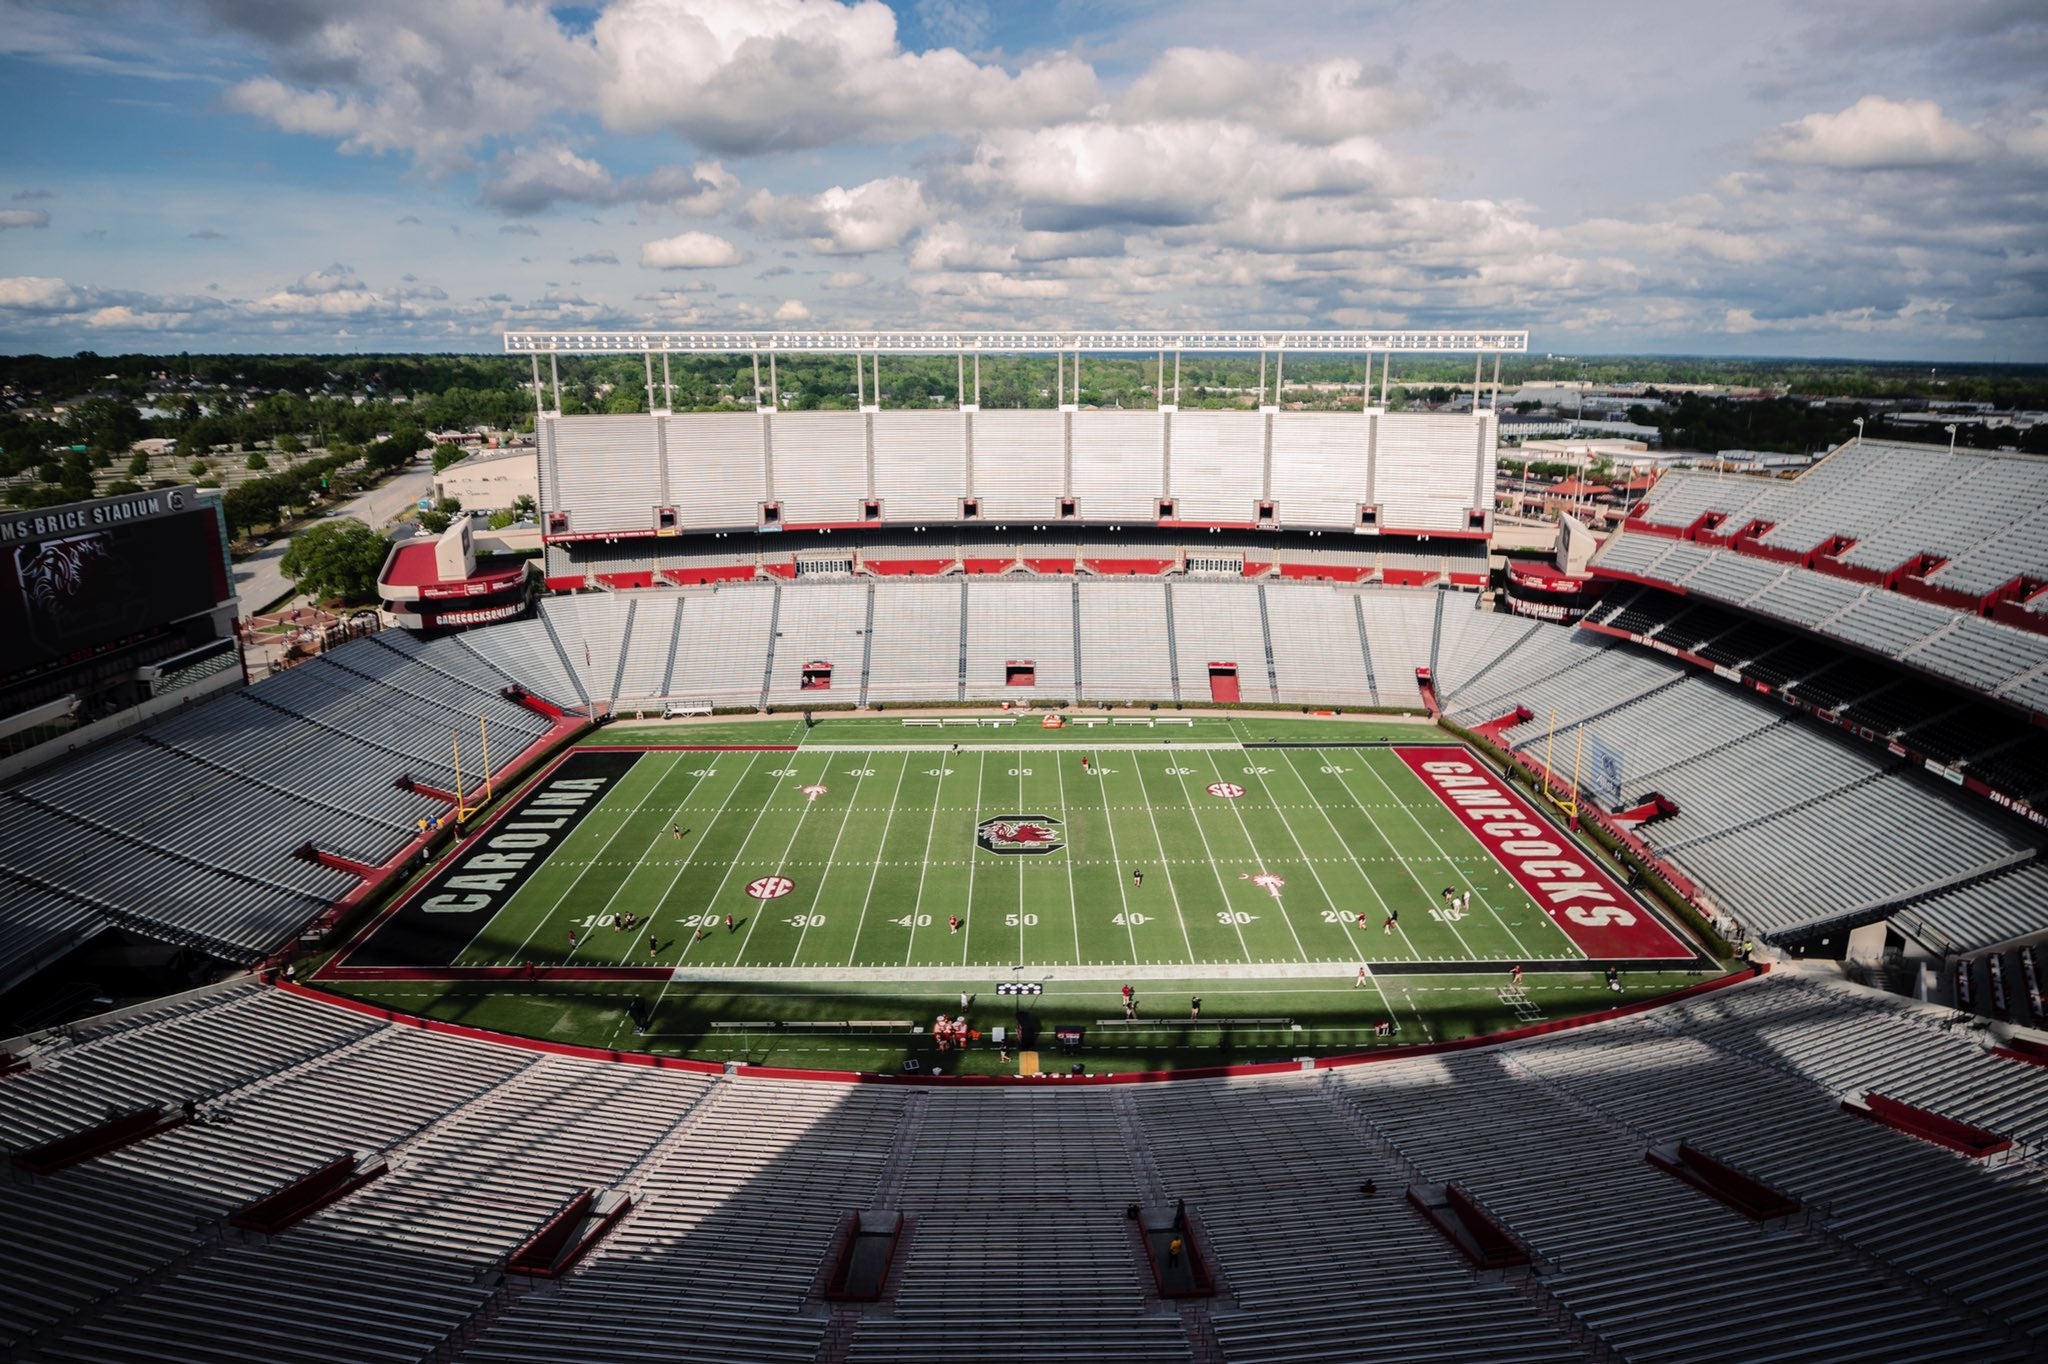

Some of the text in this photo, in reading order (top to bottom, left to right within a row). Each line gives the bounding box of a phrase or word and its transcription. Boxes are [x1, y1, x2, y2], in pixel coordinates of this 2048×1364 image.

[93, 498, 160, 524] STADIUM
[1209, 784, 1243, 797] SEC
[421, 777, 608, 913] CAROLINA
[1422, 762, 1637, 927] GAMECOCKS
[749, 881, 792, 896] SEC
[579, 914, 613, 927] 10
[684, 914, 720, 927] 20
[792, 914, 826, 927] 30
[898, 914, 932, 927] 40
[1005, 914, 1038, 927] 50
[1112, 912, 1145, 925] 40
[1217, 912, 1251, 925] 30
[1321, 911, 1356, 923] 20
[1429, 909, 1461, 922] 10
